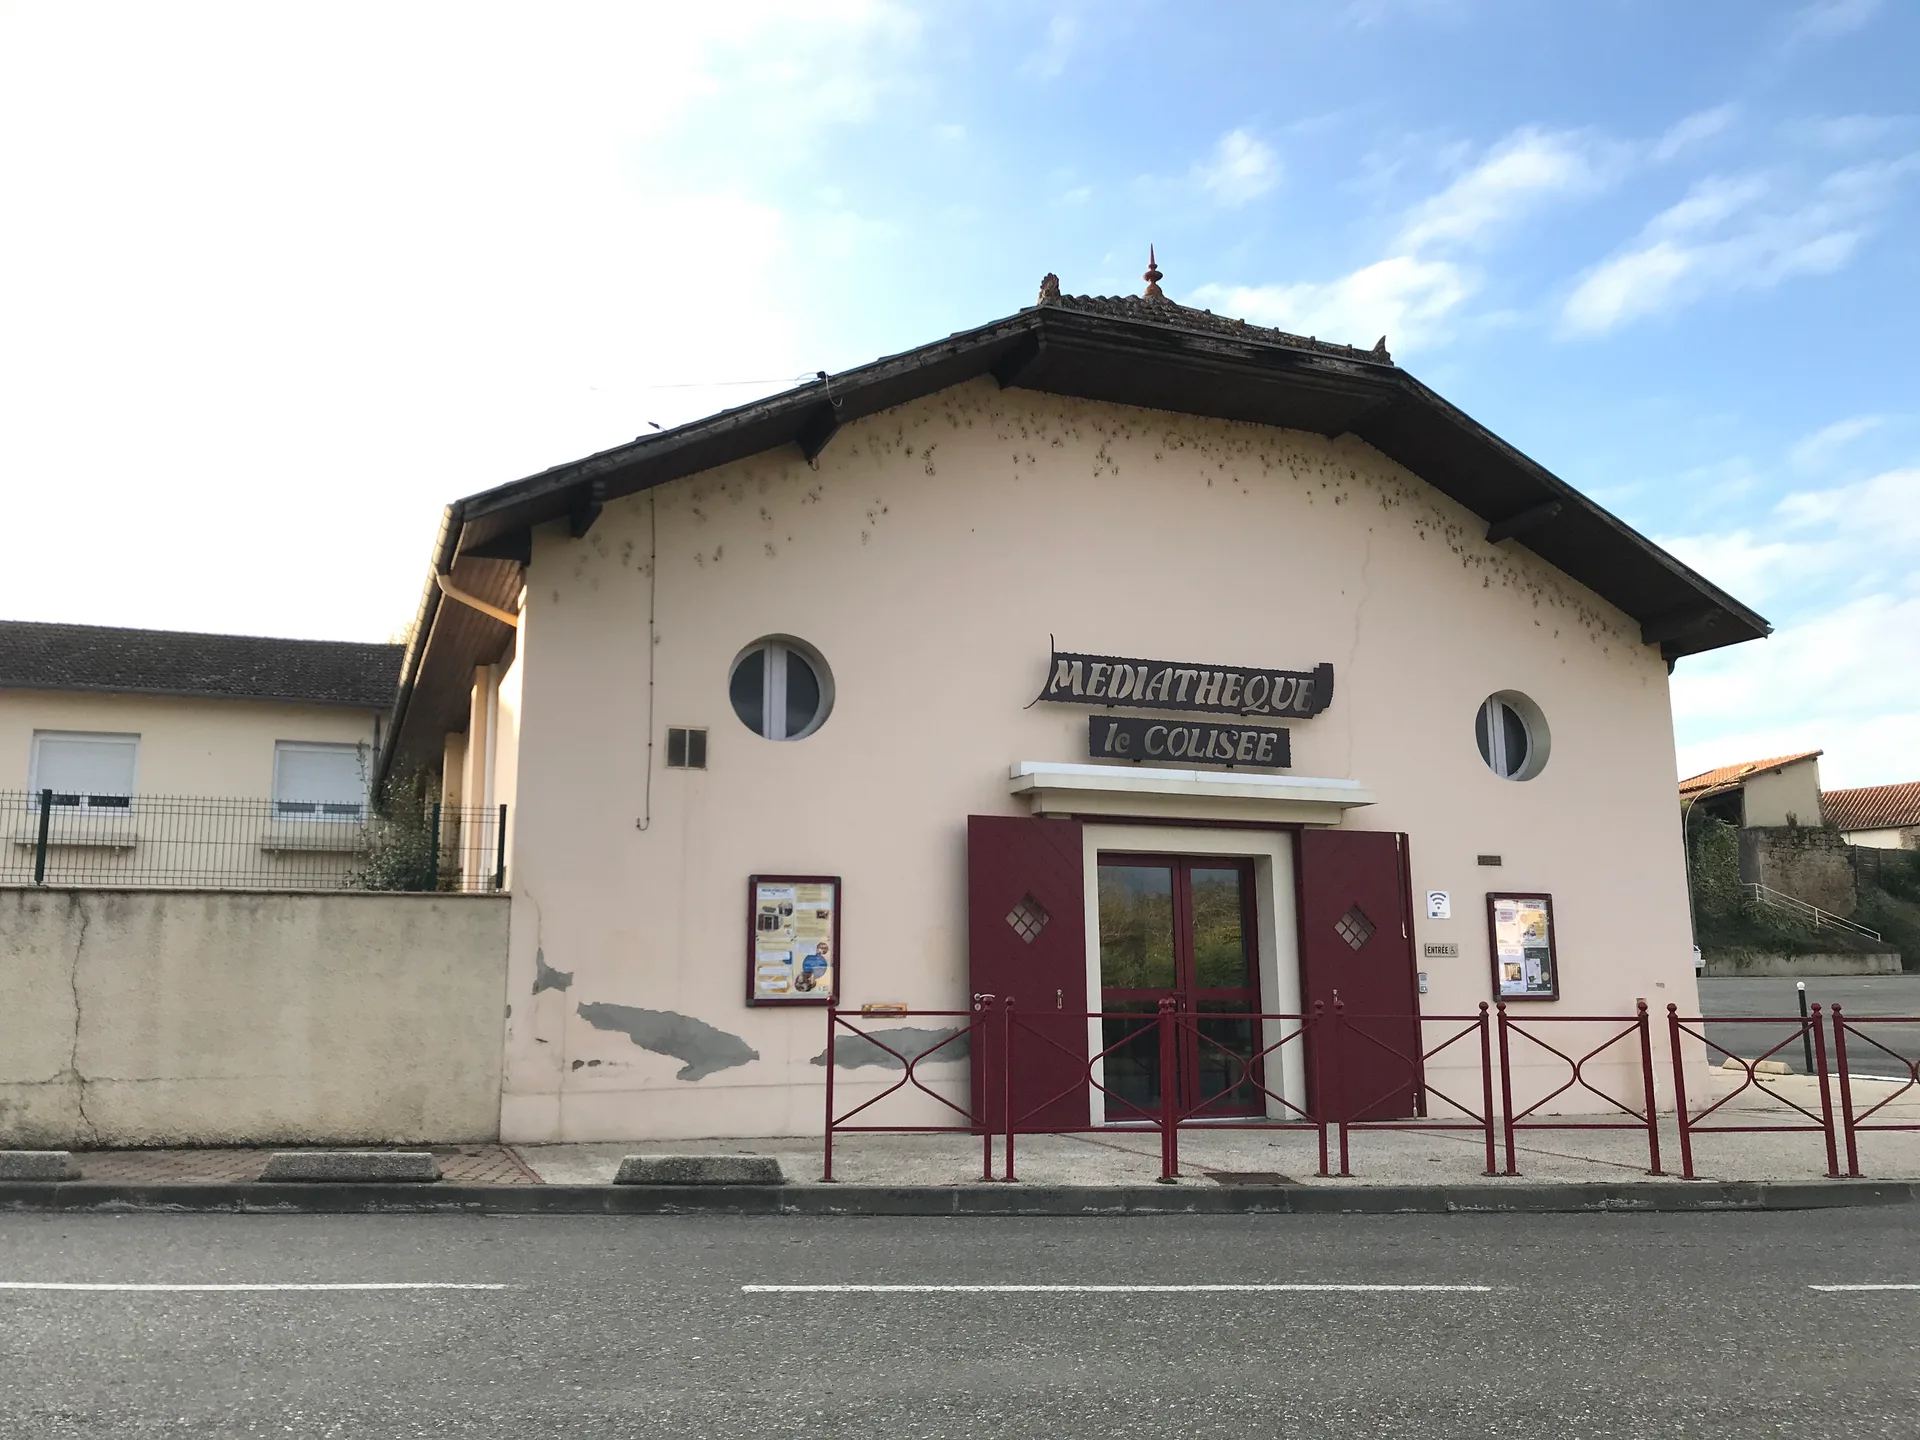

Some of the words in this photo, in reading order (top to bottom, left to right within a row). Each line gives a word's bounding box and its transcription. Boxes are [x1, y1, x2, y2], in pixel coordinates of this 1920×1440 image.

[1049, 659, 1316, 712] MEDIATHEQUE
[1104, 722, 1130, 753] le
[1144, 725, 1277, 762] COLISEE
[1427, 944, 1449, 954] ENTRÉE
